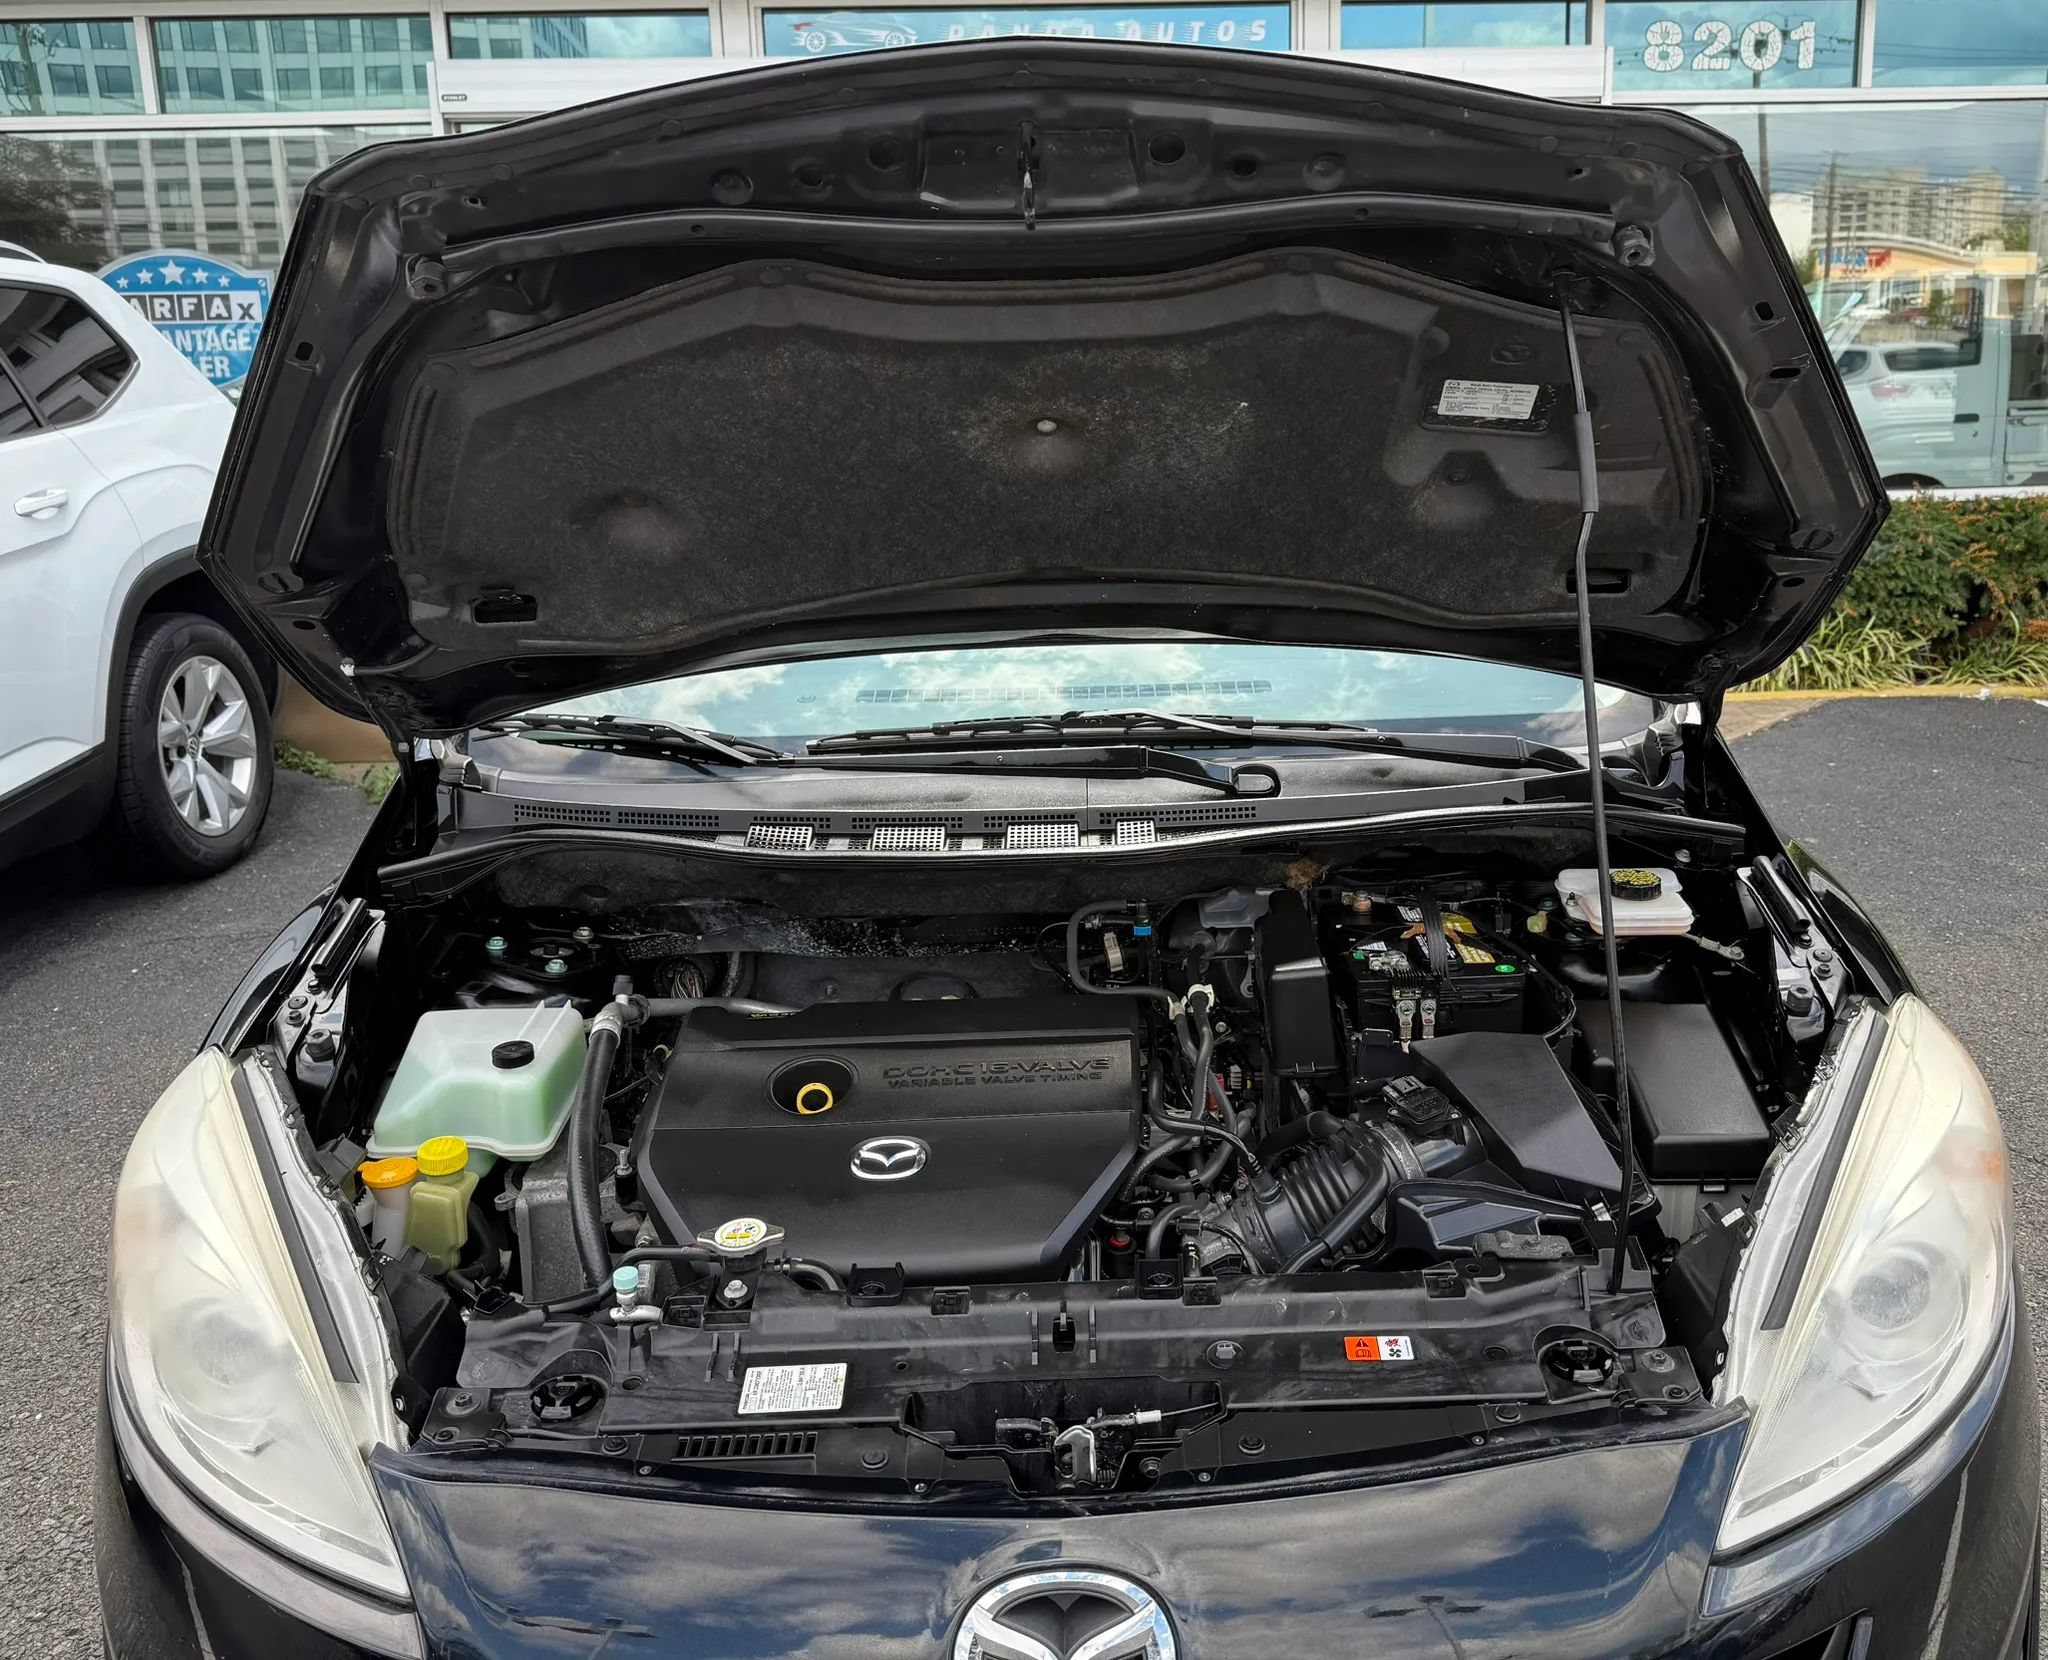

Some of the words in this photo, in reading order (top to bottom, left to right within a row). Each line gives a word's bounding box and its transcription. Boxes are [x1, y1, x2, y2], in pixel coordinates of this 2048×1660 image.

[1125, 19, 1266, 42] AUTOS
[1643, 20, 1816, 72] 8201
[883, 1064, 974, 1079] DOHC
[980, 1057, 1110, 1075] 16-VALVE
[887, 1075, 977, 1089] VARIABLE
[981, 1074, 1036, 1085] VALVE
[1040, 1072, 1103, 1083] TIMING
